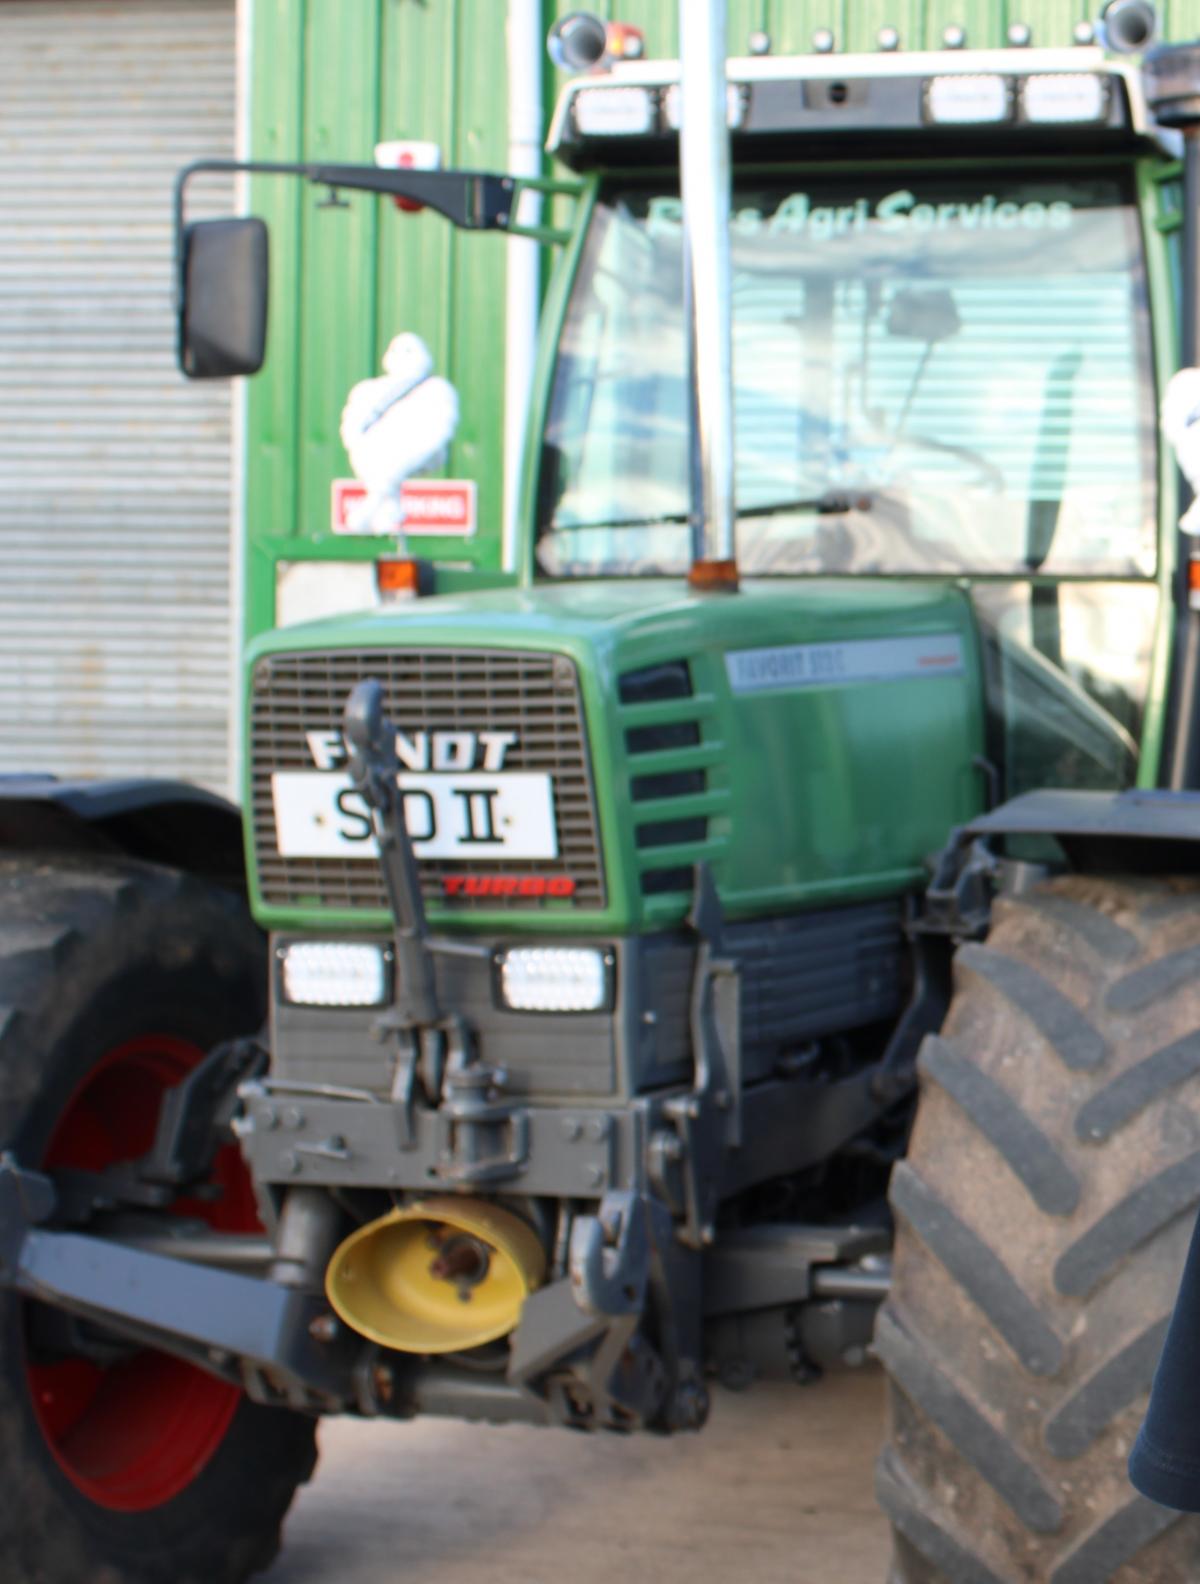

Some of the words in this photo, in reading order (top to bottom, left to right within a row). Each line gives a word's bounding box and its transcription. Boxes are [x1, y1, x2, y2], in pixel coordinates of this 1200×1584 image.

[769, 191, 868, 242] Agri
[875, 189, 1074, 233] Services
[305, 730, 518, 771] FNDT
[442, 873, 576, 897] TURBO
